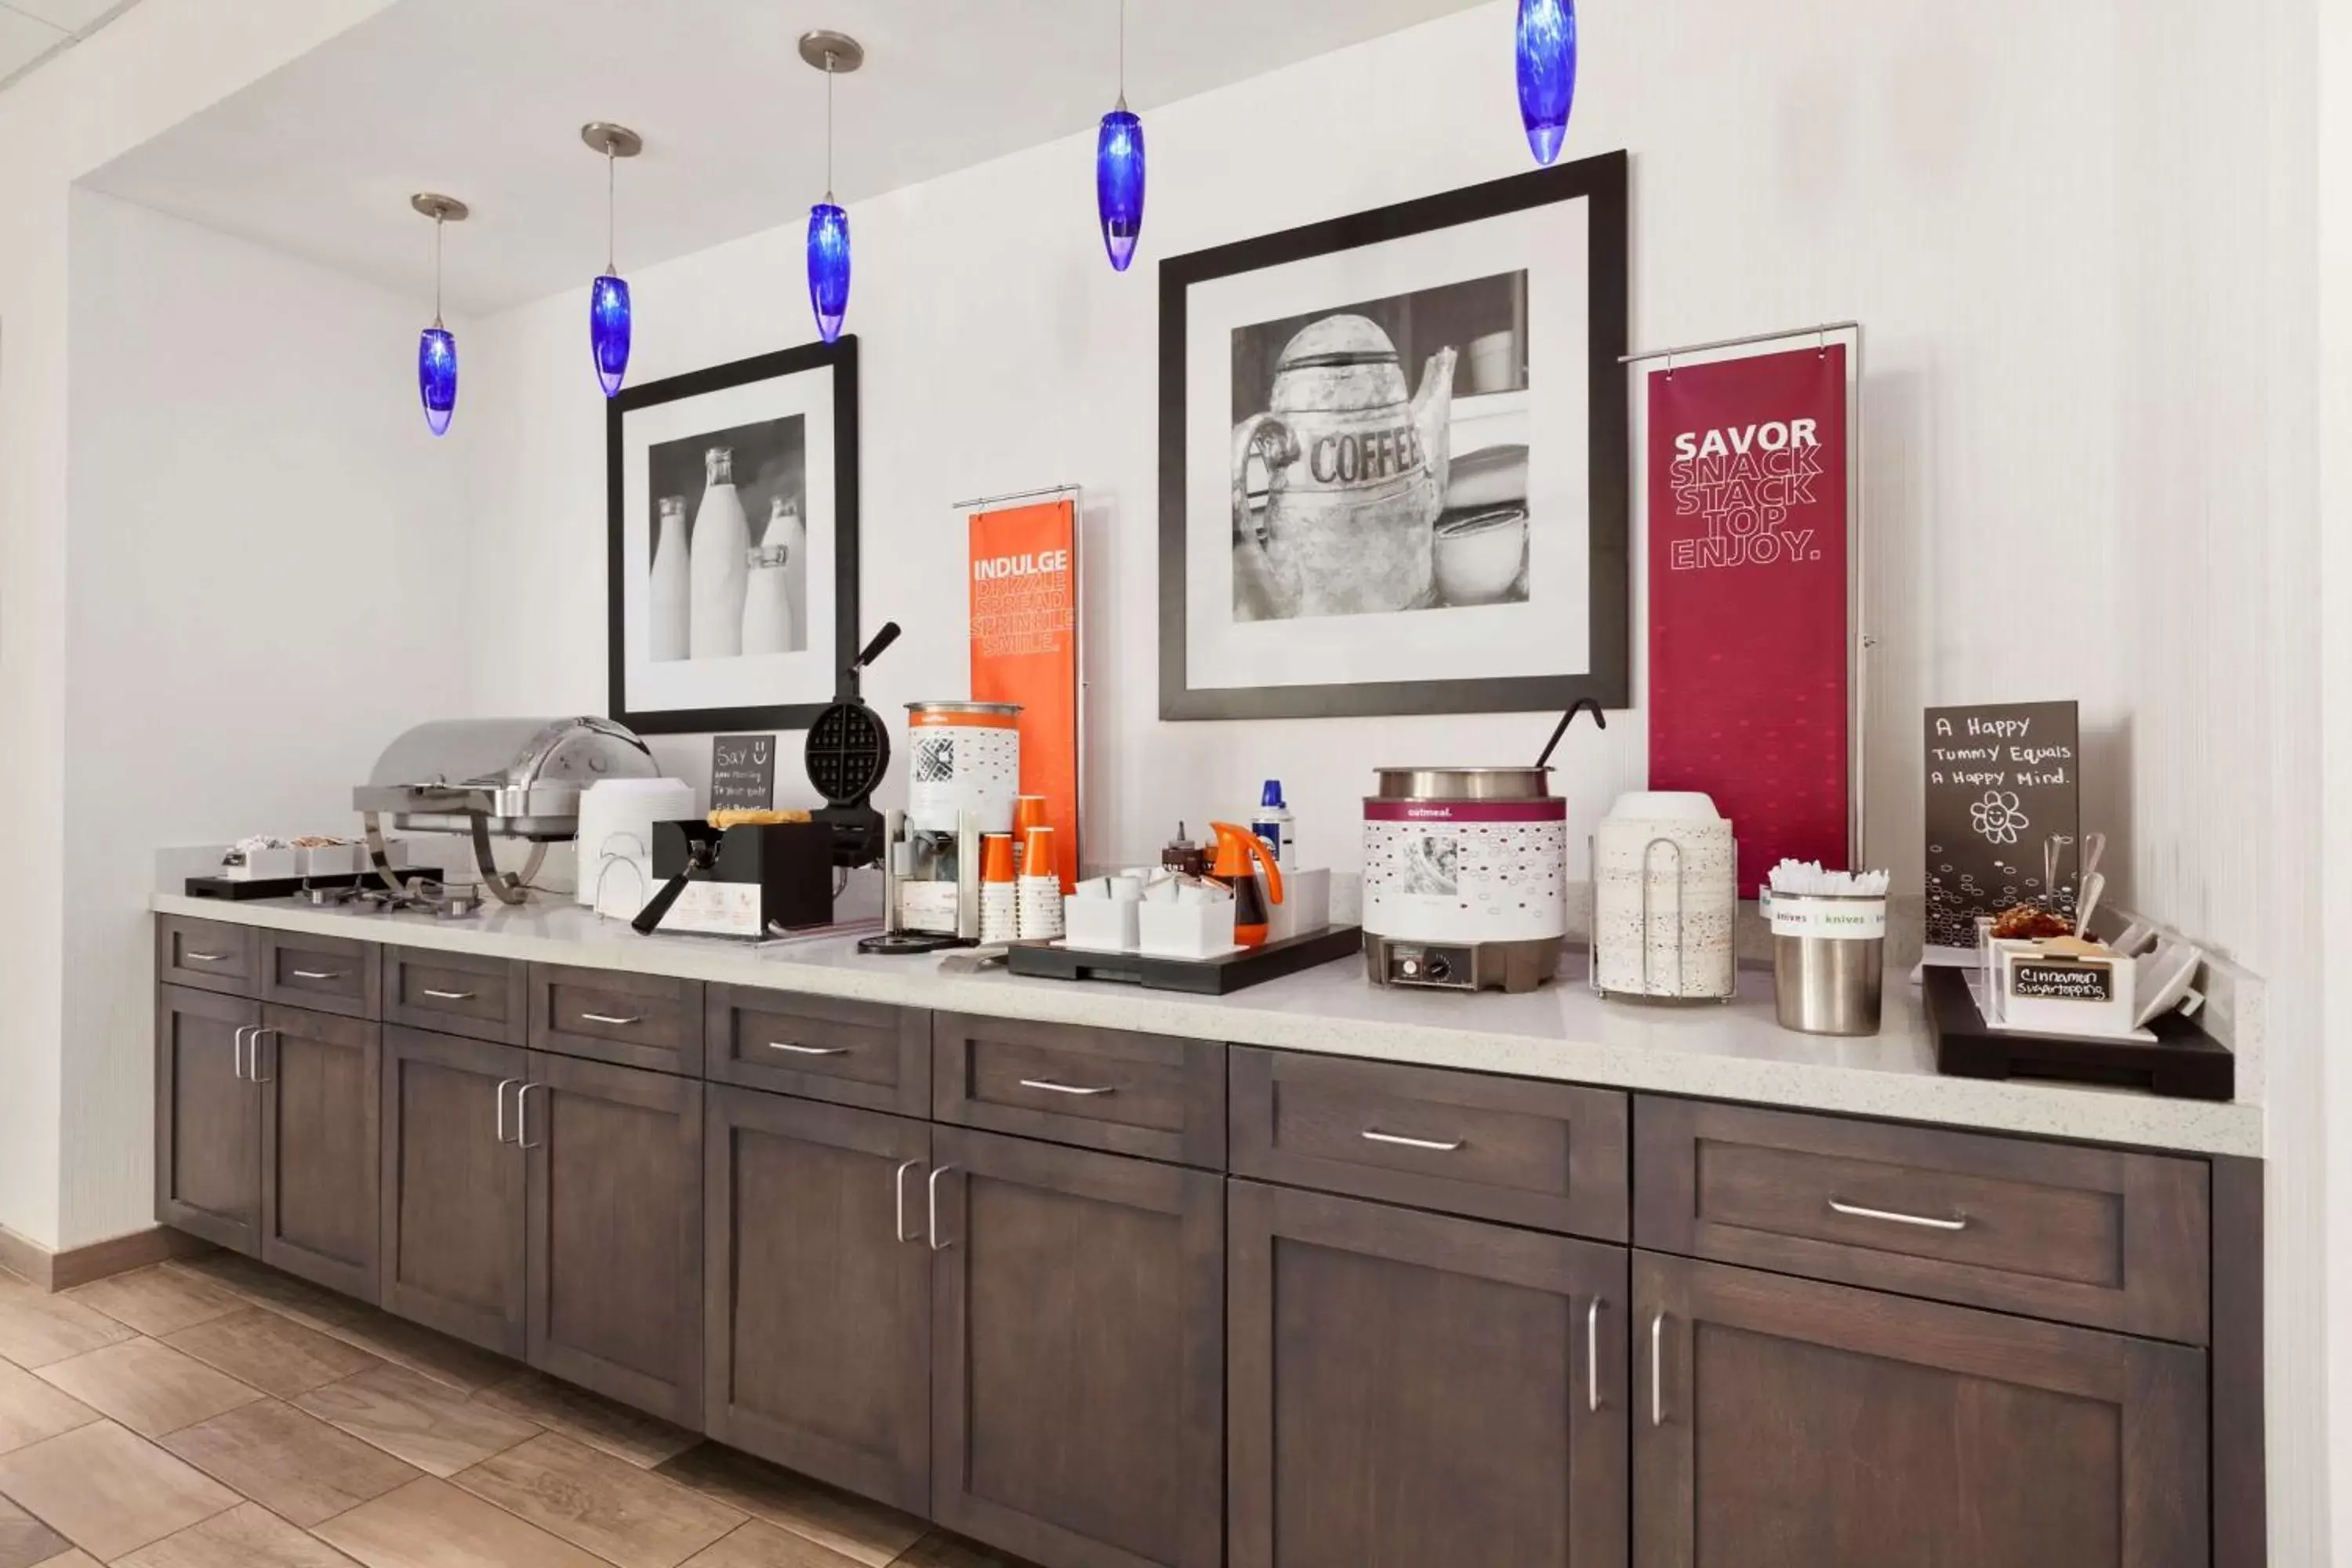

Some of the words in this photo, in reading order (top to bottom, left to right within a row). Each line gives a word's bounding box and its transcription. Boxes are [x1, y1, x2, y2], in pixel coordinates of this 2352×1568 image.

[1310, 424, 1422, 485] COFFEE
[1675, 418, 1819, 461] SAVOR
[1671, 442, 1823, 489] SNACK
[1676, 472, 1817, 515] STACK
[1703, 506, 1787, 540] TOP
[975, 550, 1067, 581] INDULGE
[1671, 529, 1821, 571] ENJOY.
[976, 572, 1066, 601] DRIZZLE
[976, 592, 1065, 617] SPREAD
[969, 608, 1076, 639] SPRINKLE
[1936, 717, 1953, 737] A
[1967, 717, 2031, 738] Happy
[1932, 745, 2000, 762] Tummy
[2009, 746, 2071, 764] Equals
[1932, 772, 1944, 784] A
[1952, 771, 2005, 786] Happy
[2017, 767, 2071, 786] Mind.
[1825, 913, 1865, 924] knives
[2020, 968, 2097, 984] Cinnamon
